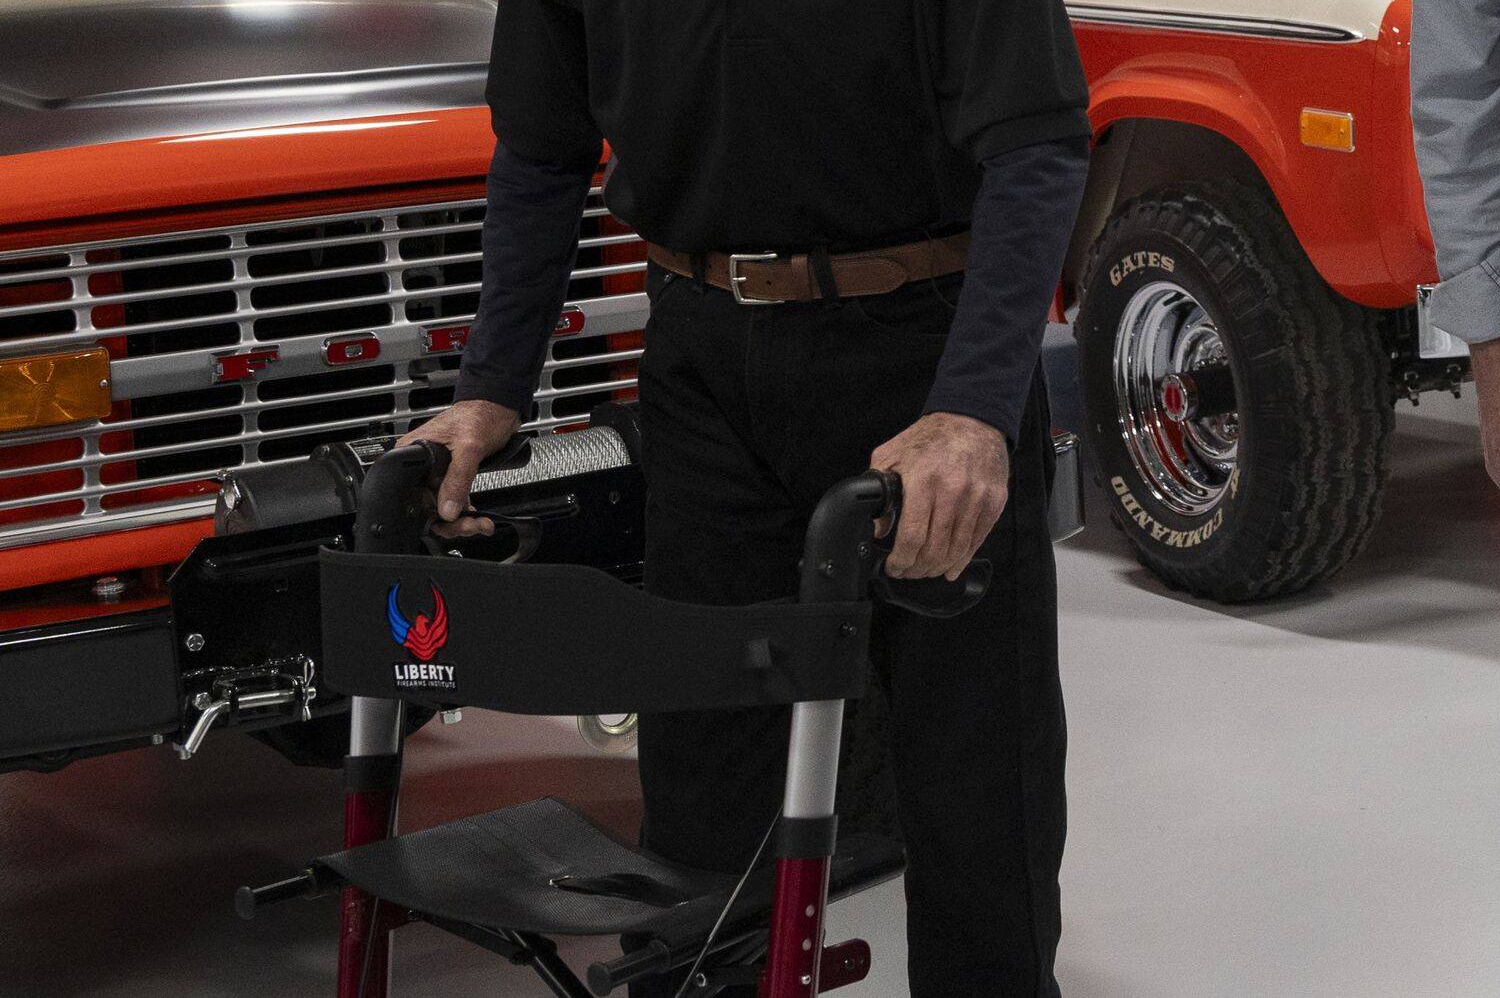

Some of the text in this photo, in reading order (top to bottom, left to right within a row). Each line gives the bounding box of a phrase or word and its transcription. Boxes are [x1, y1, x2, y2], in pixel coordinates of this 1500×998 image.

[1109, 250, 1175, 288] GATES
[1111, 475, 1224, 549] COMMANDO
[394, 664, 455, 681] LIBERTY
